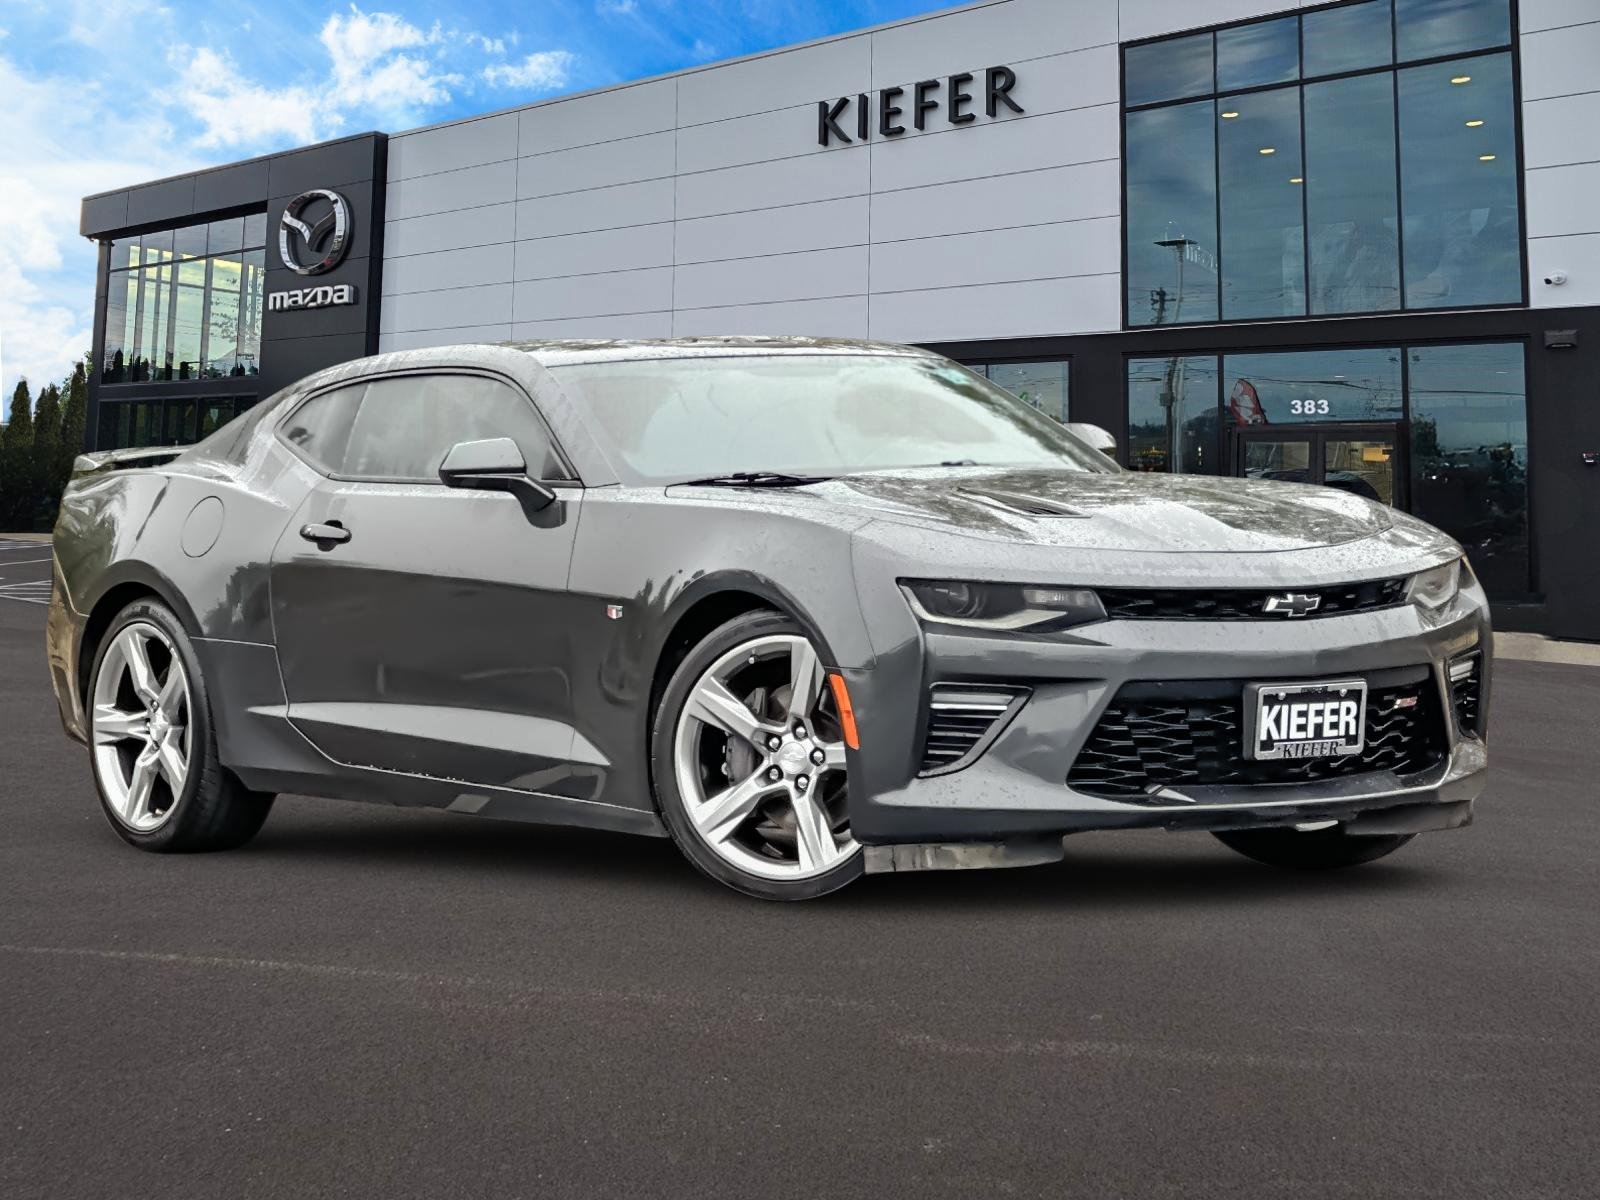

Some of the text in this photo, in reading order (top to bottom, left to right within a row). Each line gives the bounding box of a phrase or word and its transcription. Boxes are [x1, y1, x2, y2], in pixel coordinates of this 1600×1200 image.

[818, 65, 1025, 146] KIEFER
[1290, 399, 1330, 415] 383
[1259, 700, 1358, 741] KIEFER
[1283, 741, 1339, 759] KIEFER
